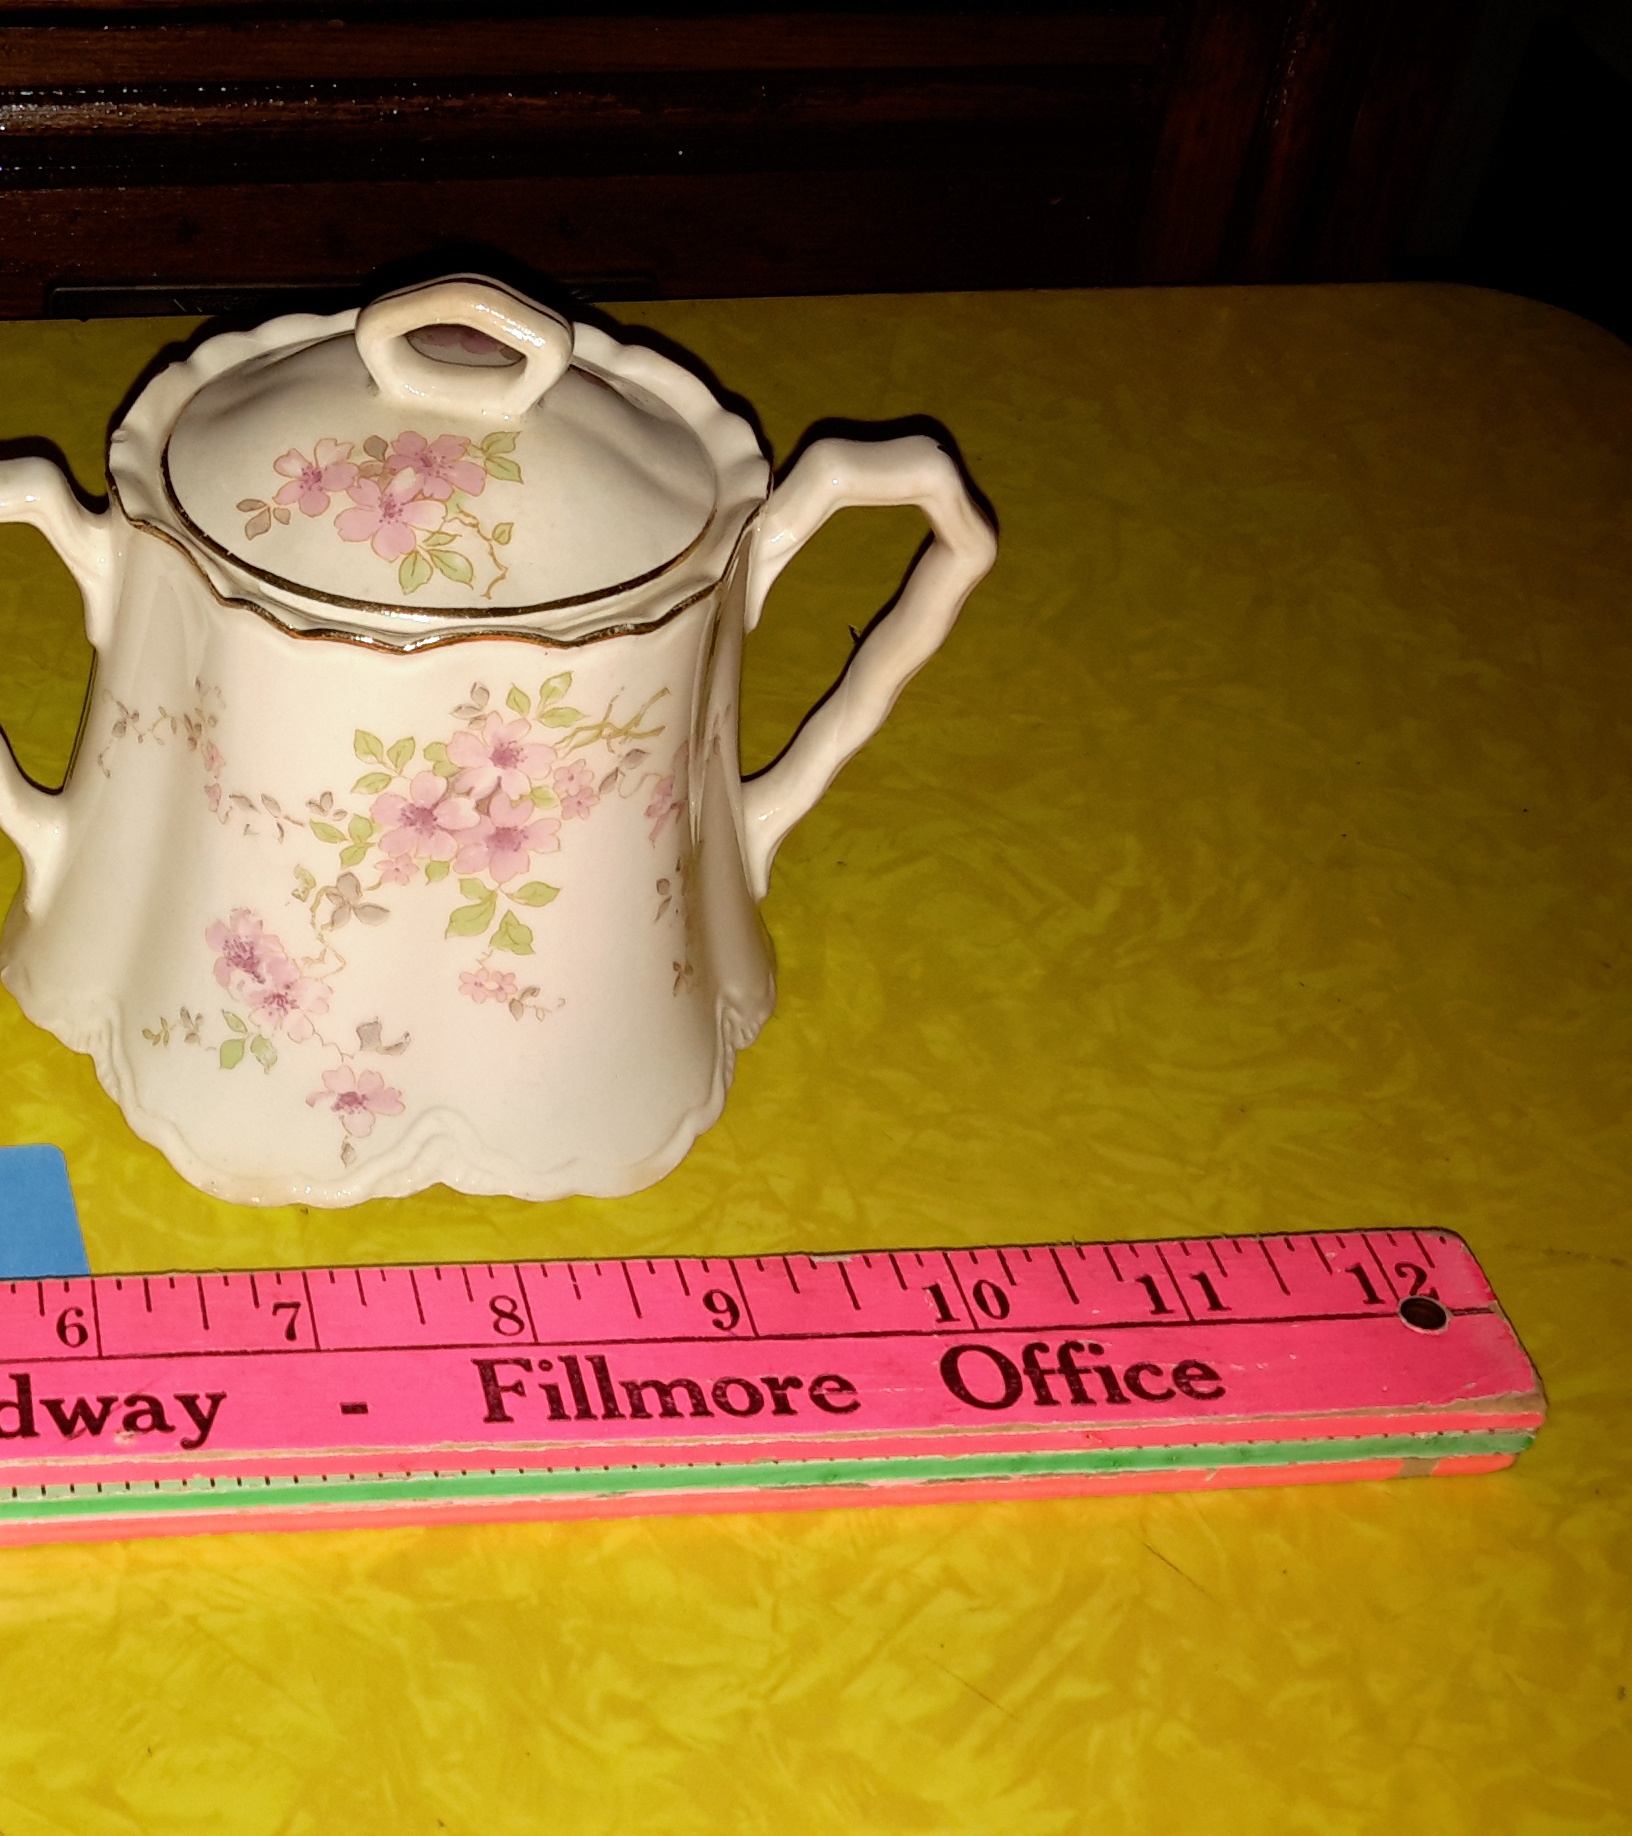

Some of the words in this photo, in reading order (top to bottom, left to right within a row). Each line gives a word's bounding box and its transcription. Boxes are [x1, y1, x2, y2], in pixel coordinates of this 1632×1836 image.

[56, 1308, 90, 1349] 6
[272, 1301, 301, 1341] 7
[489, 1295, 526, 1336] 8
[703, 1289, 740, 1330] 9
[472, 1355, 861, 1423] Fillmore
[939, 1339, 1226, 1410] Office
